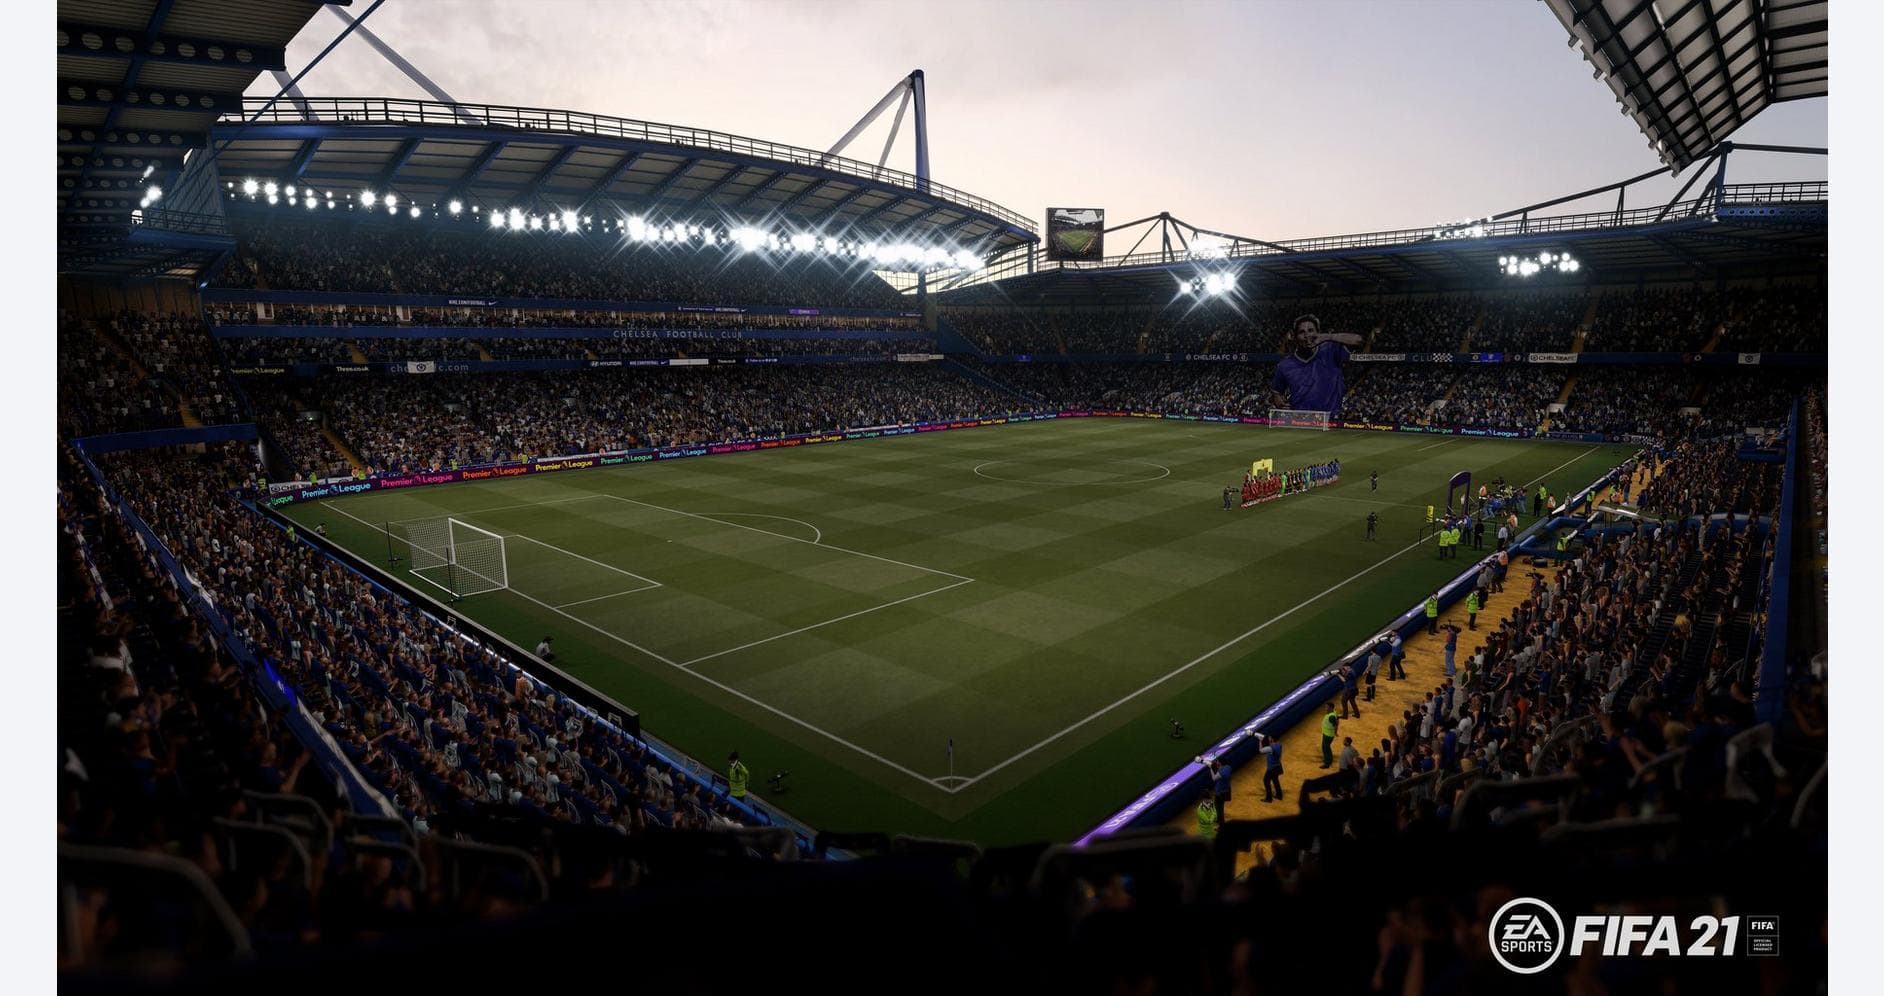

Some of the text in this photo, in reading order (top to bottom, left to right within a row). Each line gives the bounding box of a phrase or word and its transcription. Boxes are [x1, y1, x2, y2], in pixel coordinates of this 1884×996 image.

[666, 330, 714, 339] FOOTBALL
[1343, 422, 1394, 432] Premier League
[1400, 425, 1453, 435] Premier League
[826, 434, 842, 442] League
[864, 431, 880, 439] League
[1461, 428, 1520, 439] Premier League
[712, 446, 733, 454] Premier
[736, 443, 756, 451] League
[760, 441, 780, 449] Premier
[784, 439, 801, 447] League
[659, 448, 707, 459] Premier League
[600, 454, 653, 465] Premier League
[535, 460, 593, 472] Premier League
[462, 466, 528, 480] Premier League
[380, 474, 453, 488] Premier League
[302, 482, 372, 499] Premier League
